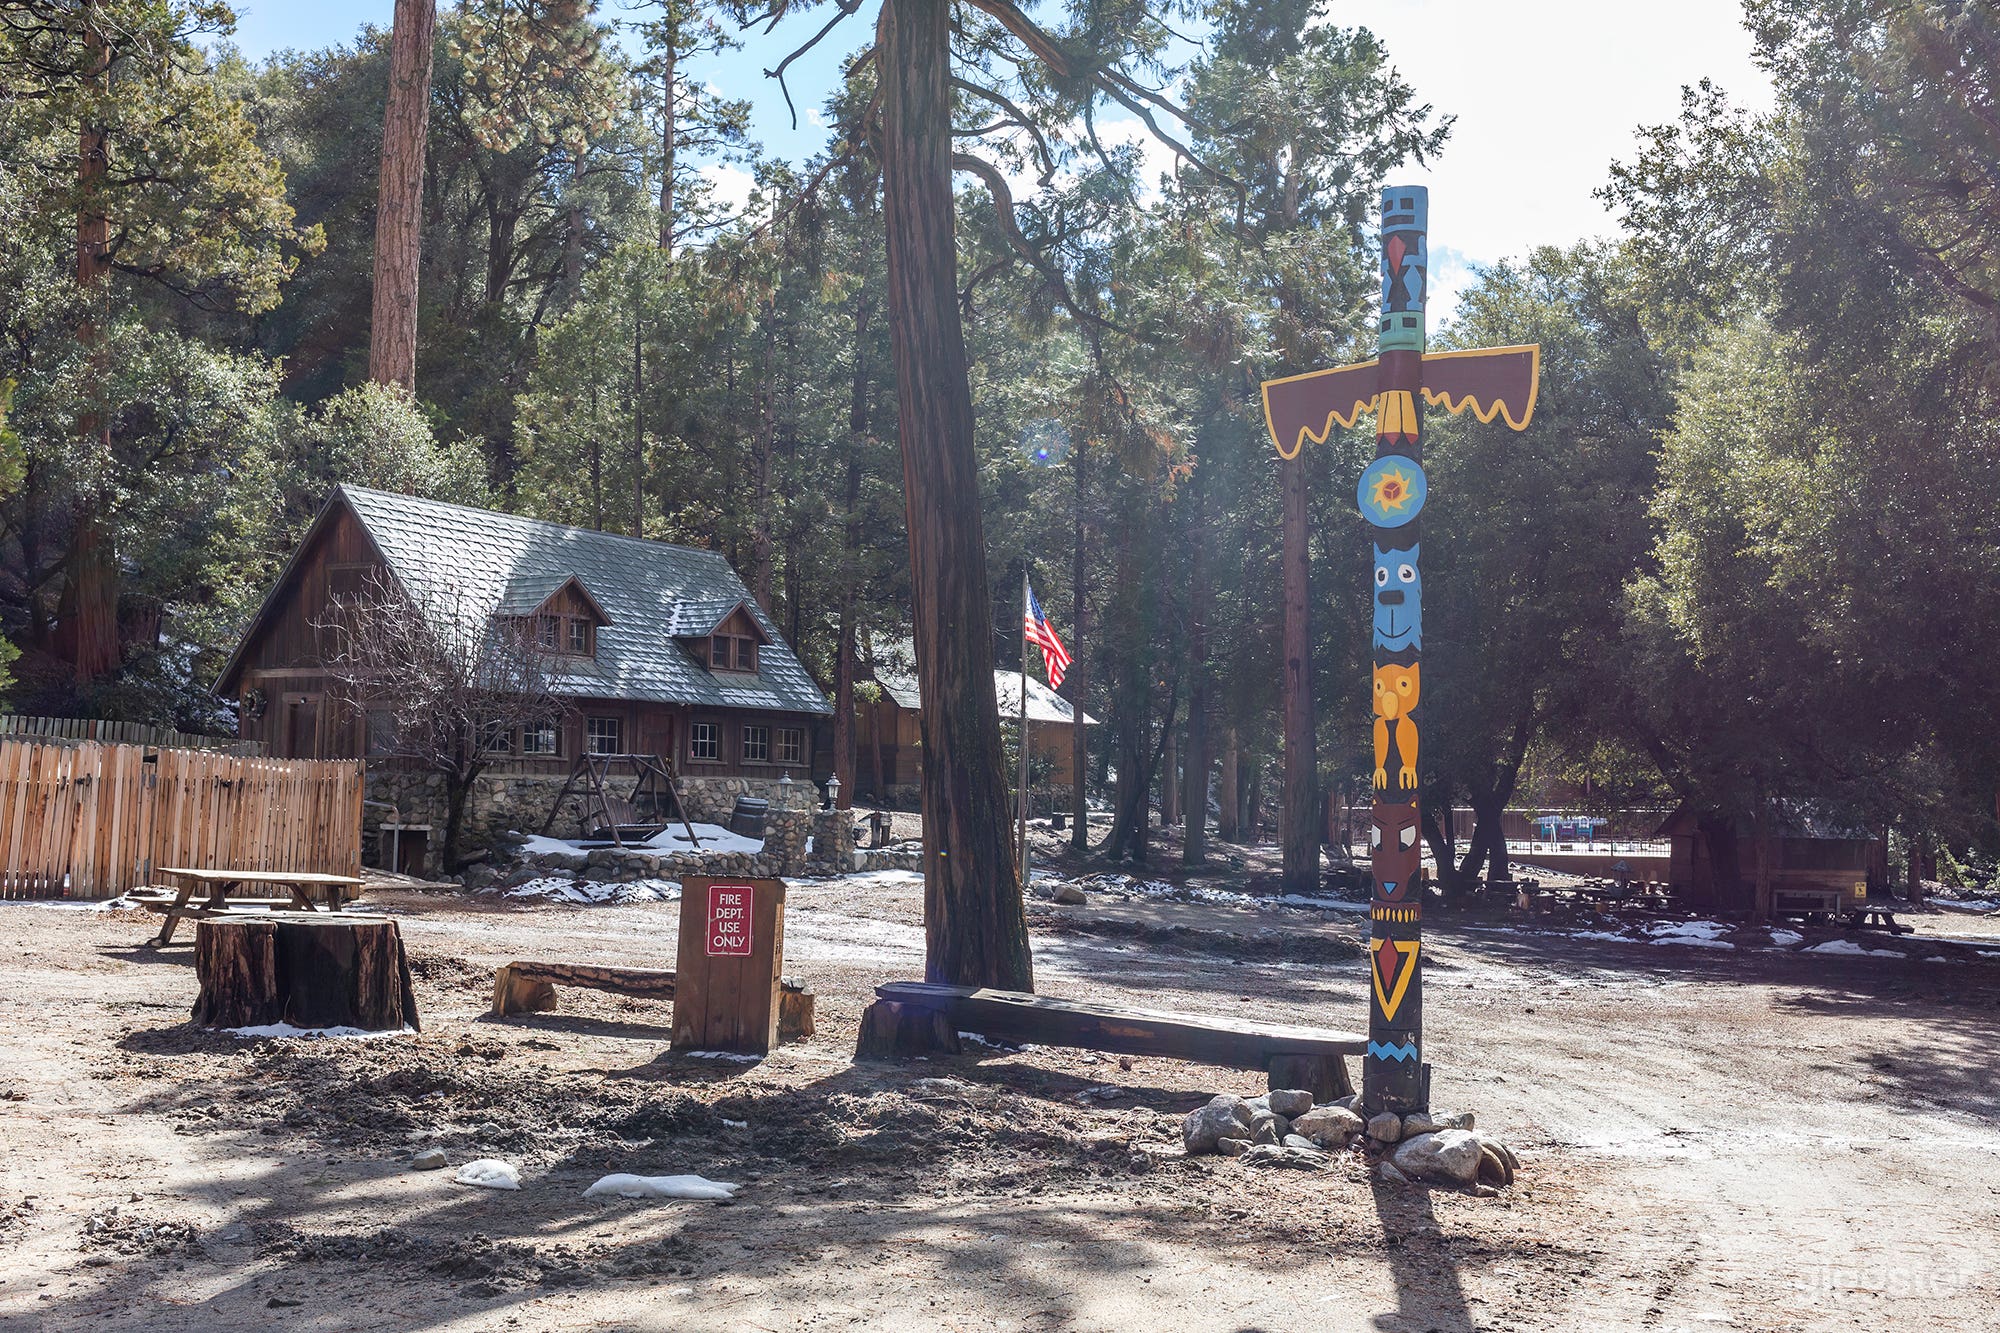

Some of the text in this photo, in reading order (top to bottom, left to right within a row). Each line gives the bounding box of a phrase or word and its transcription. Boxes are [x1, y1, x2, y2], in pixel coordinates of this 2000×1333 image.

[719, 893, 742, 905] FIRE
[715, 907, 744, 919] DEPT.
[718, 922, 740, 933] USE
[713, 935, 745, 947] ONLY
